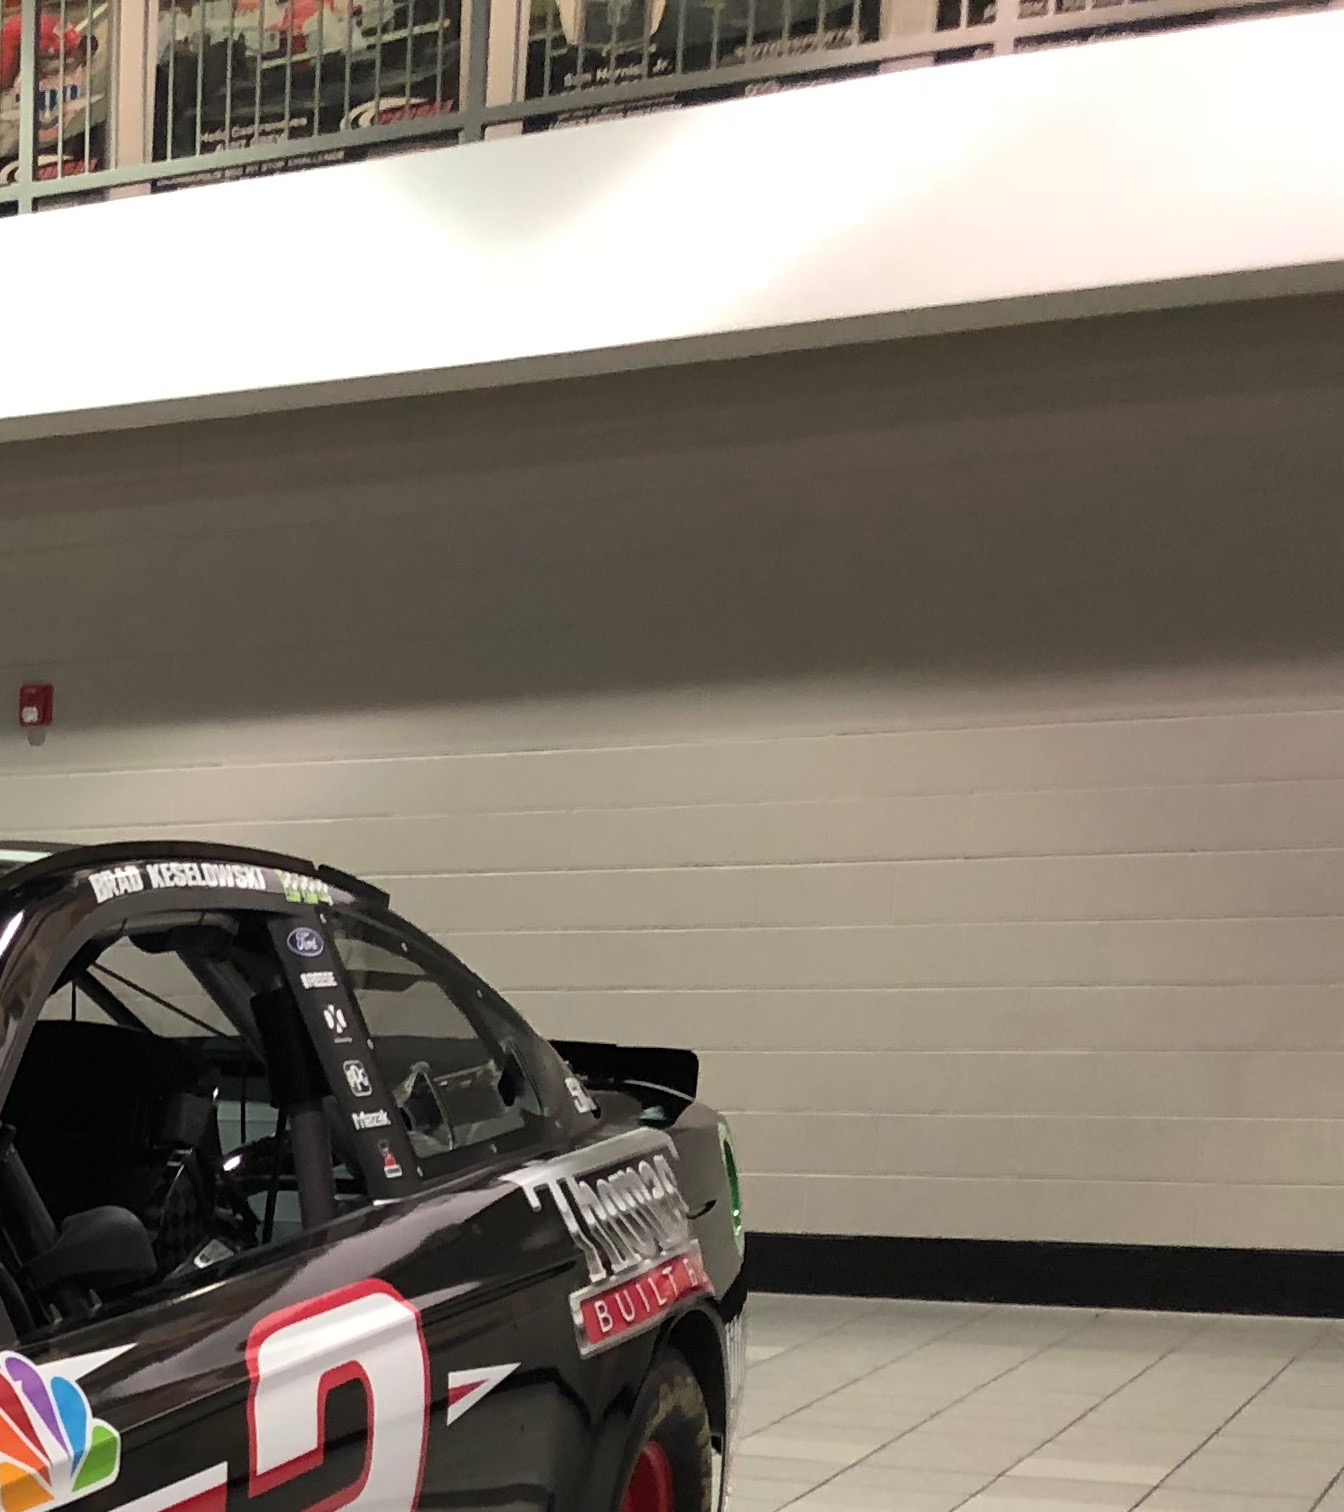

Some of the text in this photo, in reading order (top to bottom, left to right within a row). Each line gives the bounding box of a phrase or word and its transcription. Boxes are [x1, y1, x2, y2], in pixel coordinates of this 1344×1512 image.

[88, 866, 144, 904] BRAD
[145, 862, 267, 891] KESELOWSKI
[594, 1265, 679, 1334] BUILT
